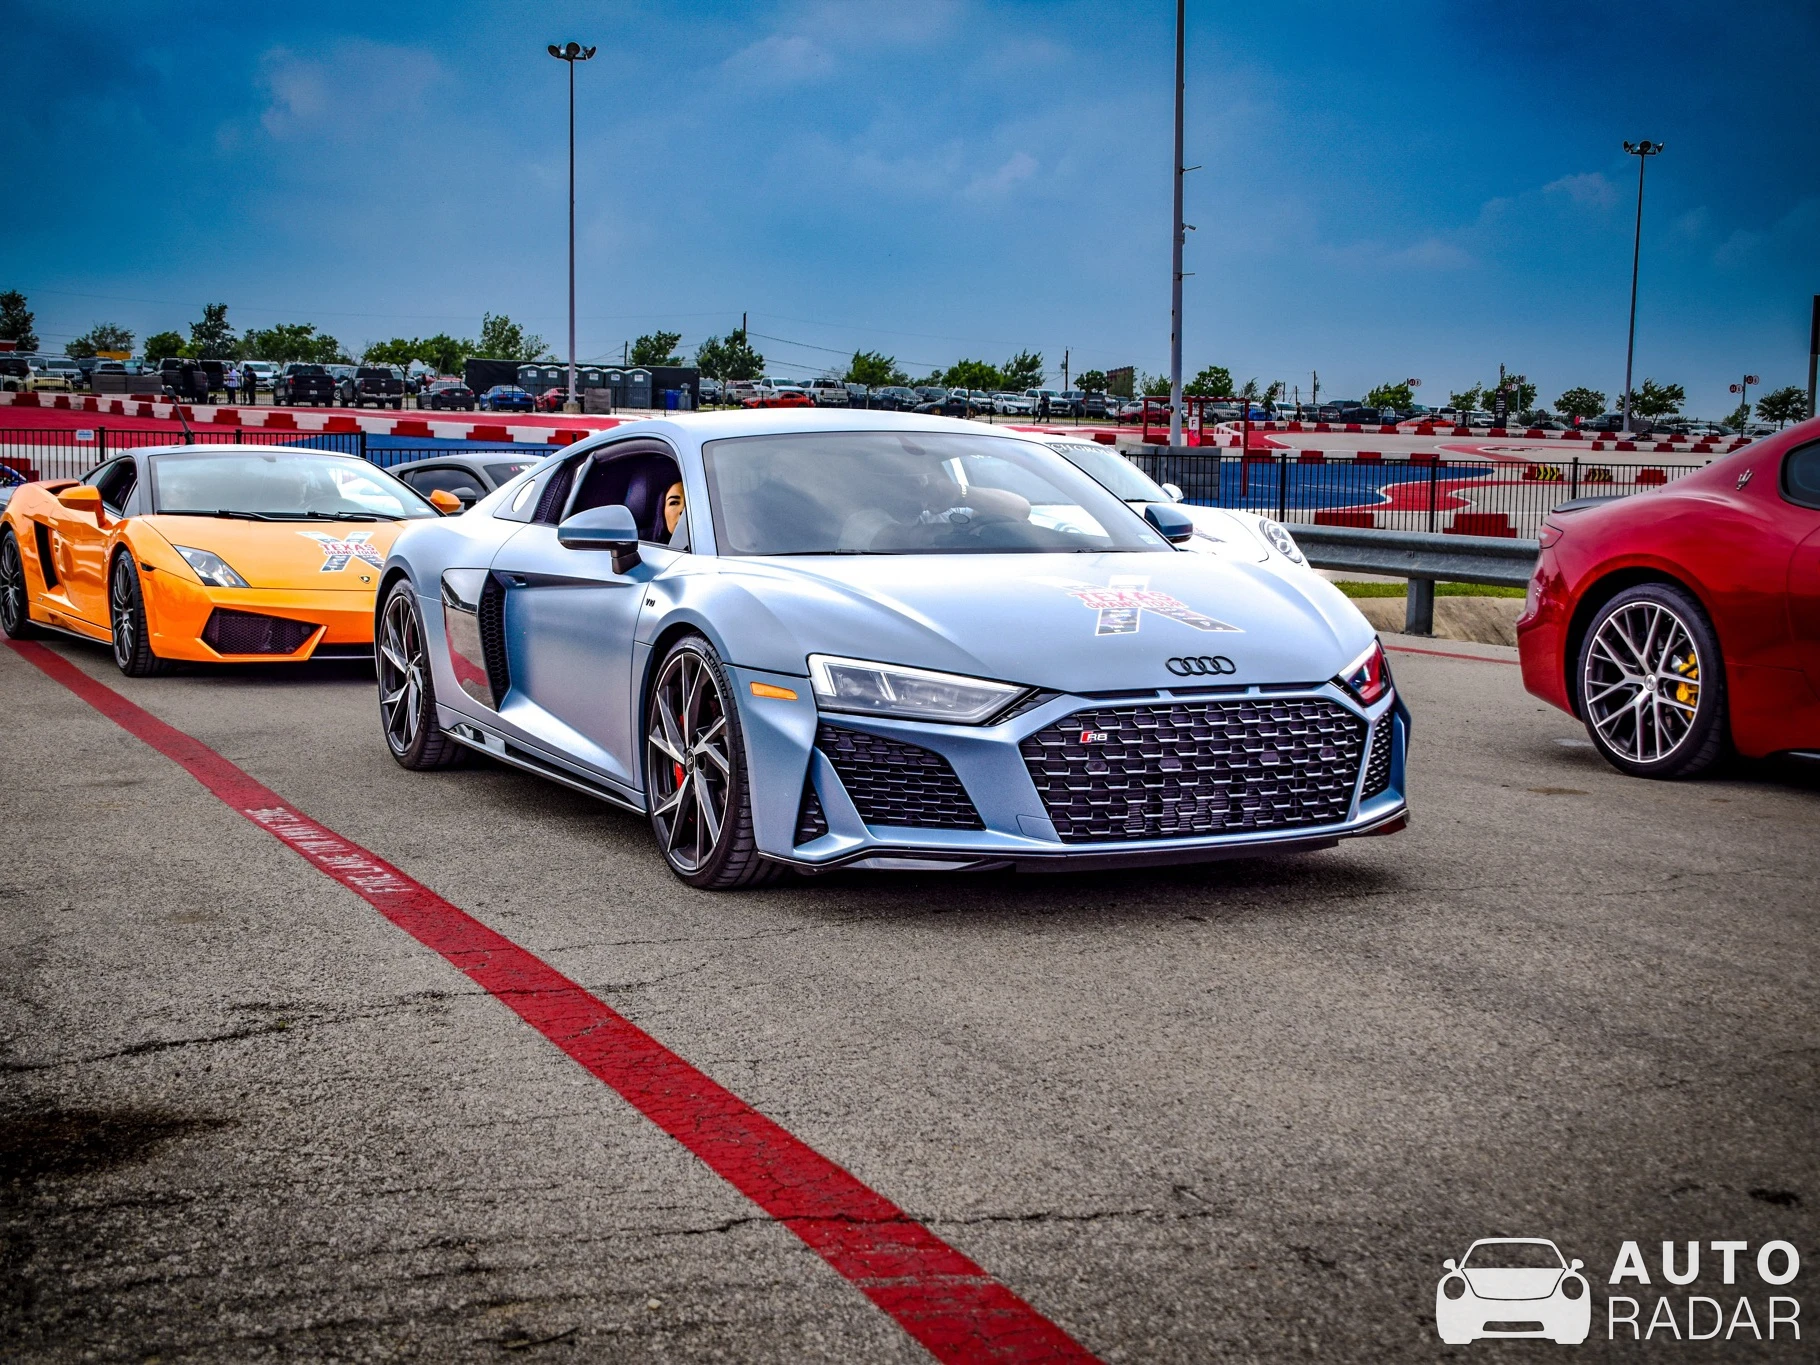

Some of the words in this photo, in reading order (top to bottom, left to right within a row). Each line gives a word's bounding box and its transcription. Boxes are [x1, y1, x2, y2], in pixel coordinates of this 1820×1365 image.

[1191, 419, 1197, 427] F
[320, 543, 375, 551] TEXAS
[1070, 591, 1174, 601] TEXAS
[708, 657, 729, 697] MICHELIN
[1085, 732, 1108, 741] R8
[244, 807, 300, 824] ZONE
[266, 823, 330, 840] AWAY
[294, 840, 351, 854] TOW
[317, 853, 384, 874] LANE
[346, 873, 413, 893] FIRE
